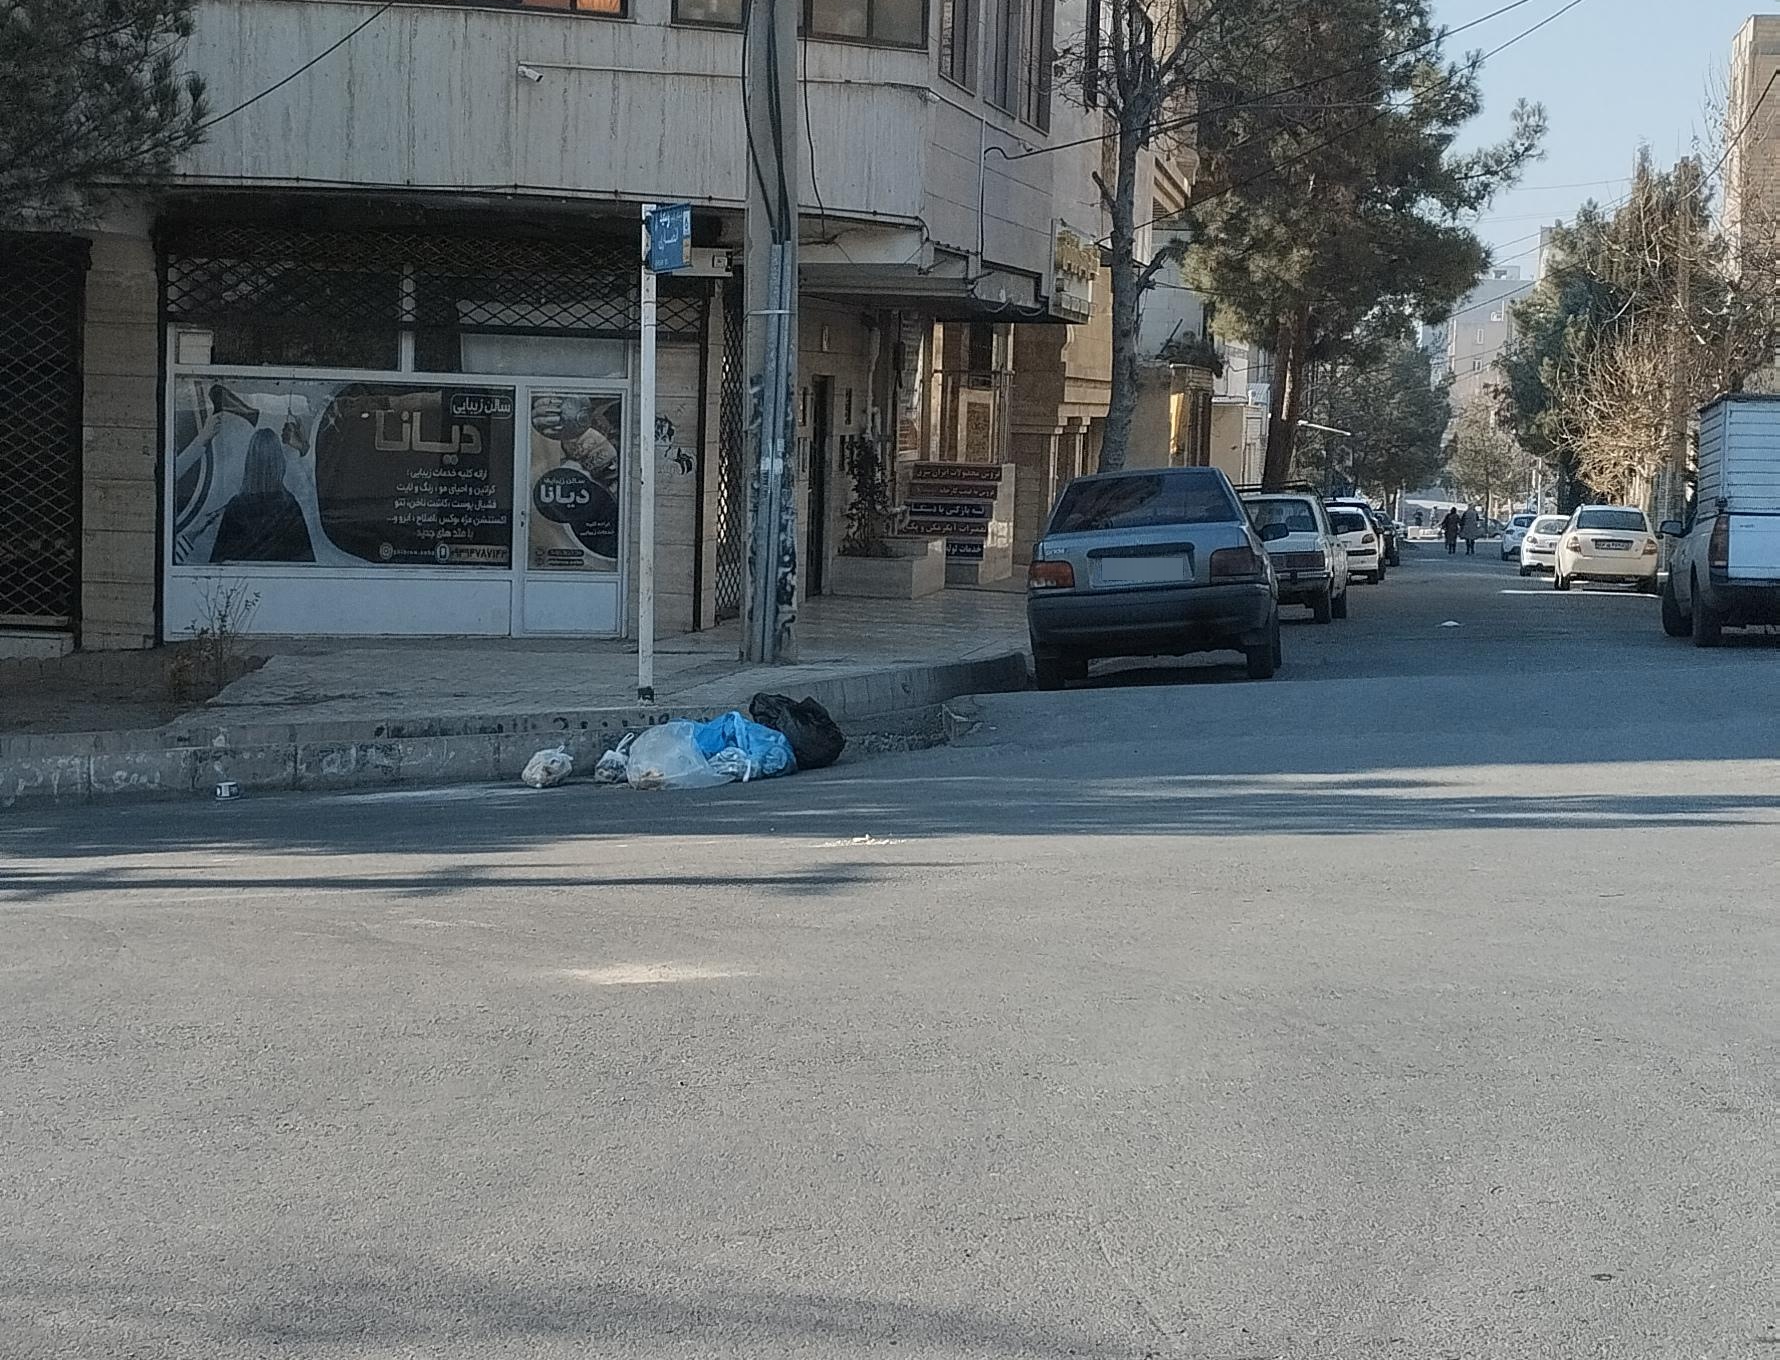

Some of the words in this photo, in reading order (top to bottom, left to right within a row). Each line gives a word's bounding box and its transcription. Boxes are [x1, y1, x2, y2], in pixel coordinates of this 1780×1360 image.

[452, 397, 483, 415] زیبایی
[484, 399, 511, 414] سالن
[375, 410, 482, 465] دیانا
[410, 468, 432, 480] زیبایی
[432, 468, 456, 478] خدمات
[419, 482, 434, 493] رنگ
[438, 486, 447, 495] مو
[540, 484, 590, 509] دیانا
[394, 497, 406, 508] تتو
[451, 500, 474, 511] پوست
[474, 499, 497, 511] فشیال
[959, 544, 982, 554] خدمات
